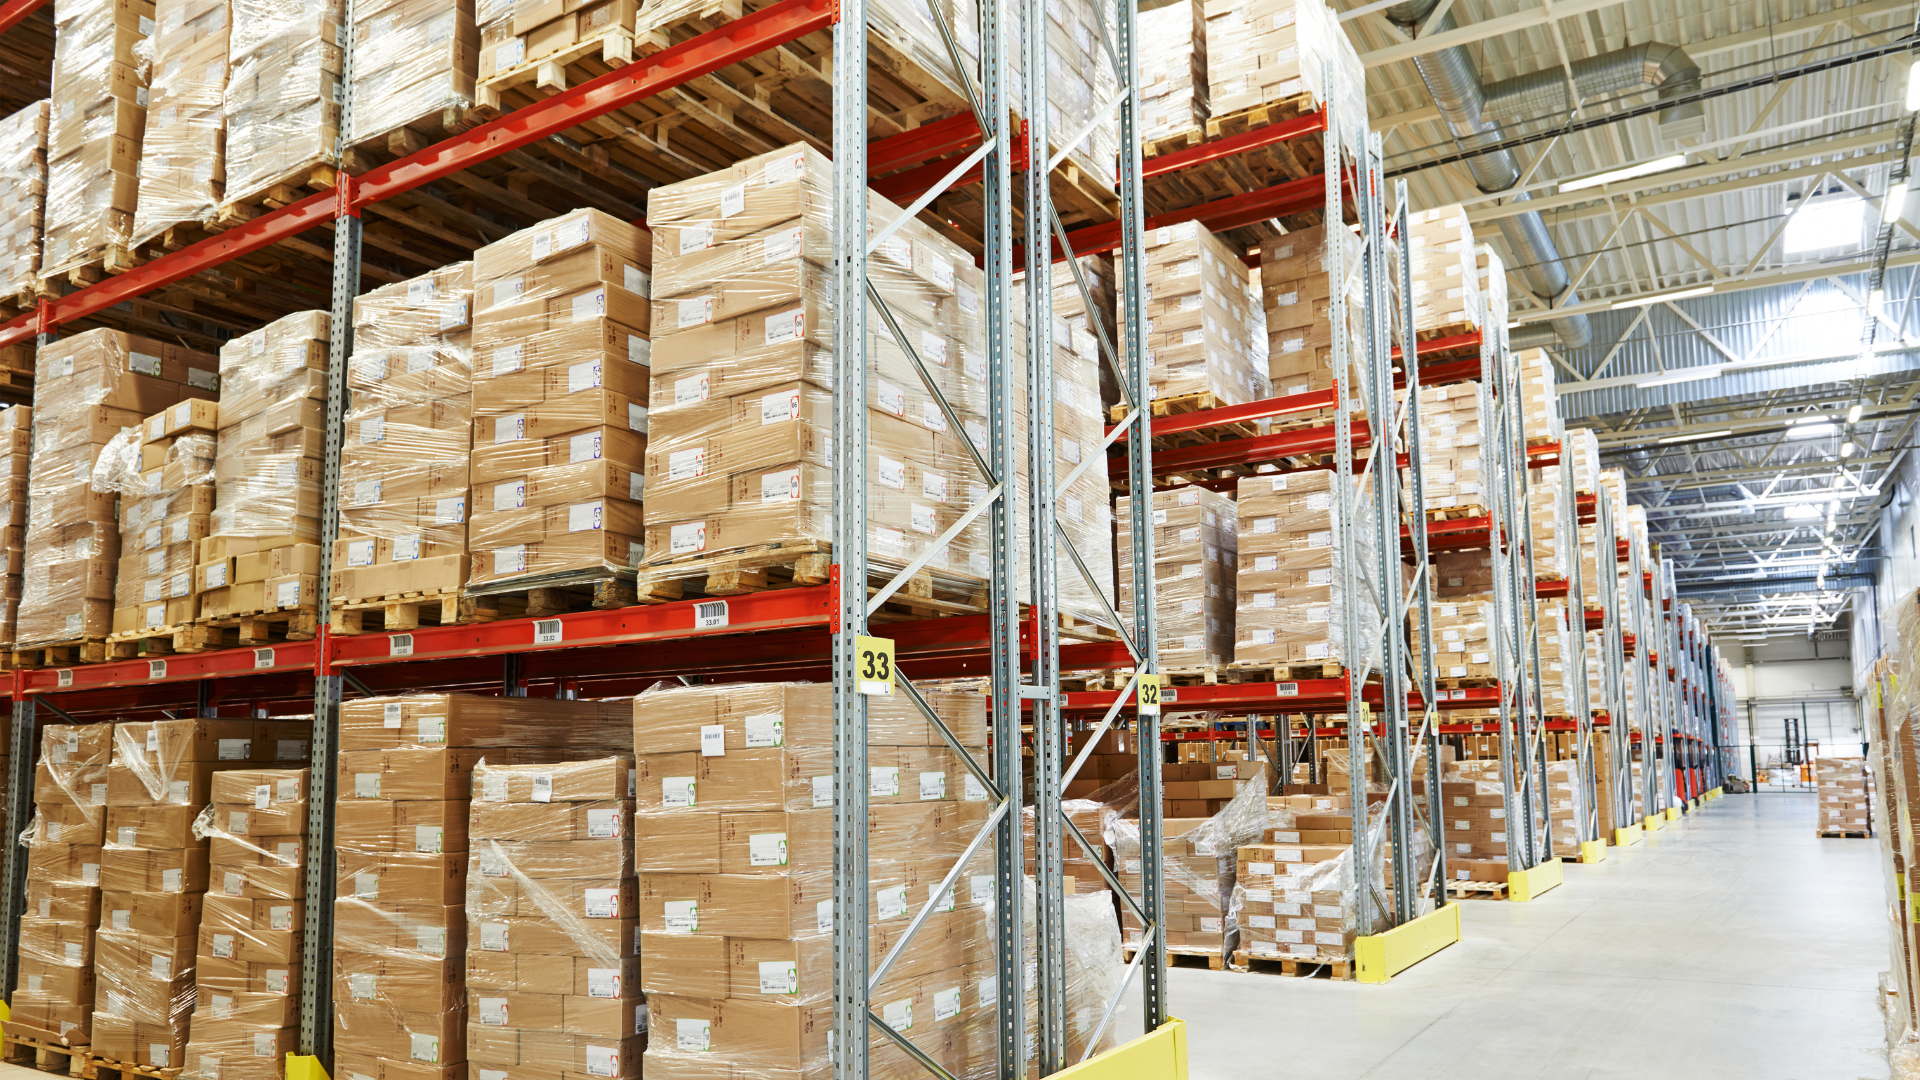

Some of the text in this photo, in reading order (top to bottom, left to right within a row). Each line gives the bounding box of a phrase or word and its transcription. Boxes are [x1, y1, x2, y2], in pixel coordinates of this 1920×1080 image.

[706, 618, 720, 626] 33.01
[862, 650, 890, 680] 33
[884, 684, 888, 694] L
[1142, 684, 1157, 704] 32
[1362, 708, 1368, 722] 31
